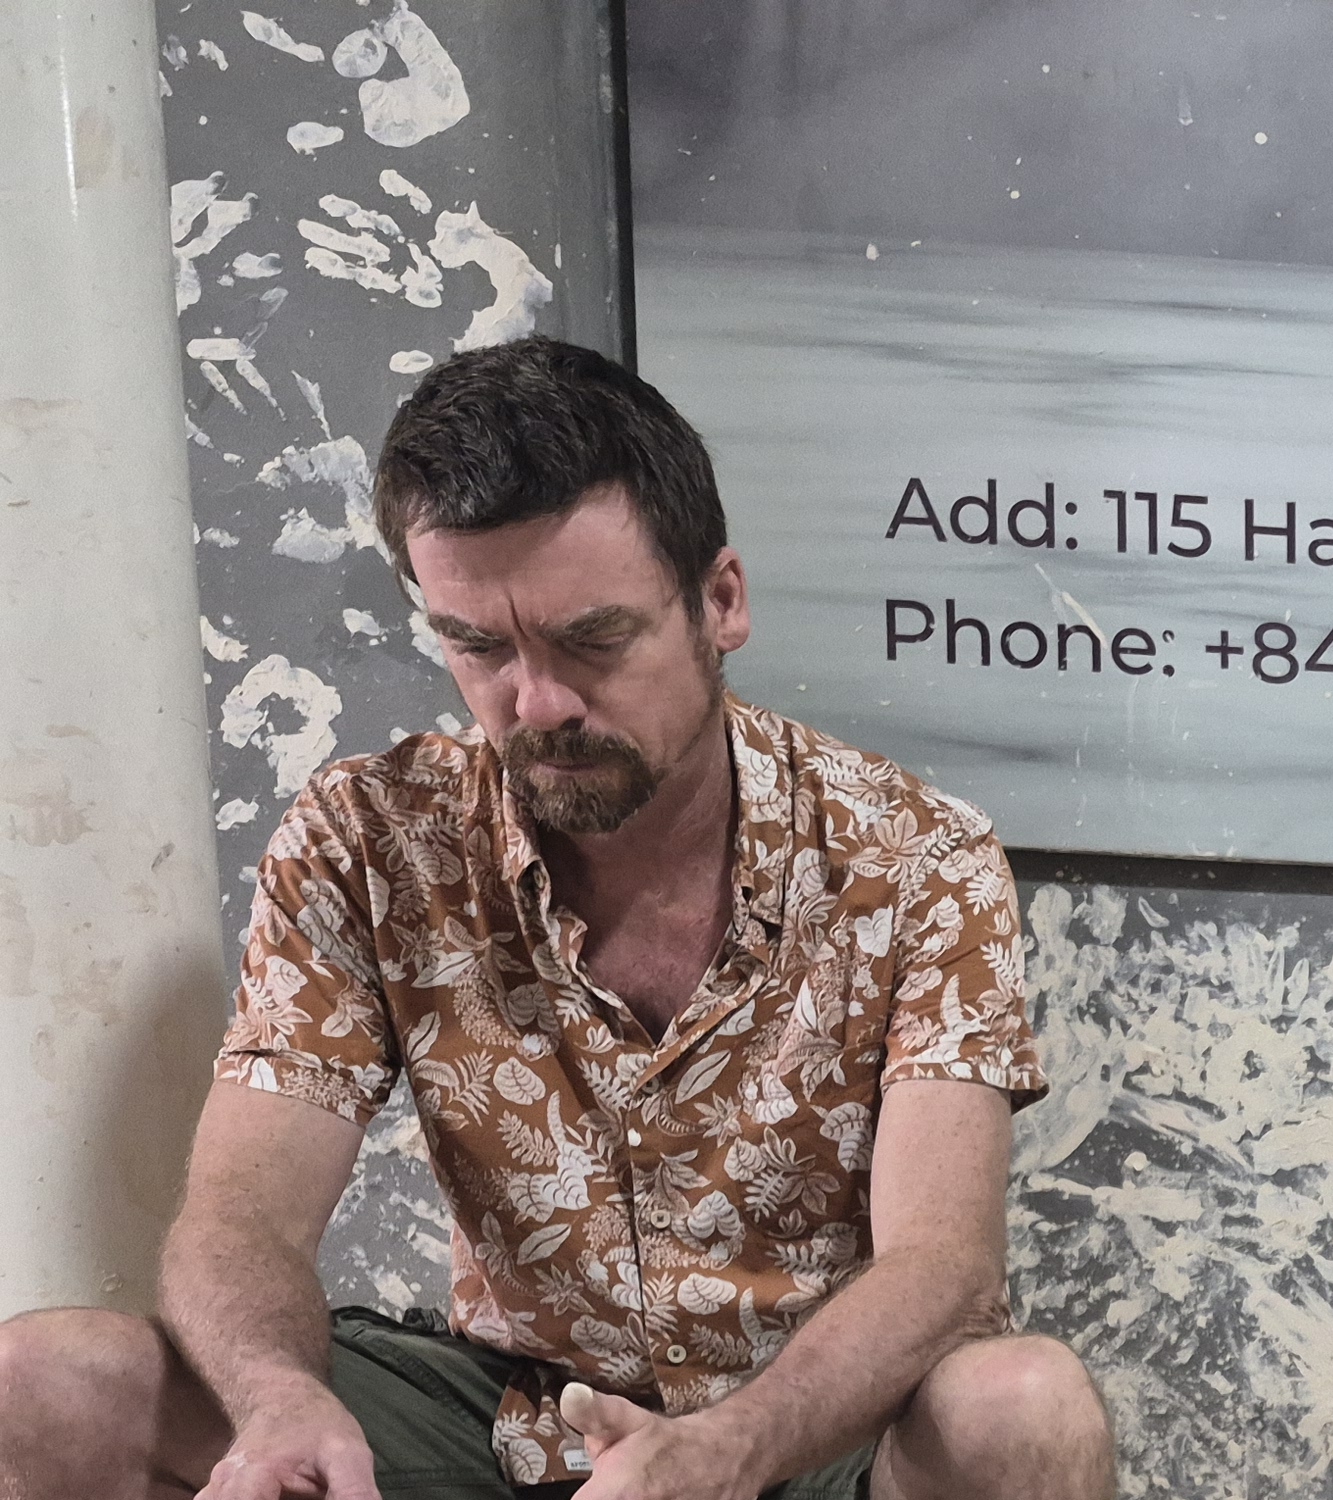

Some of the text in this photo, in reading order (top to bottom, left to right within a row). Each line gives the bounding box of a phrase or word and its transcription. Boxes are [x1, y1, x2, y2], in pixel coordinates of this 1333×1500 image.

[885, 476, 1080, 553] Add:
[1102, 488, 1213, 559] 115
[885, 598, 1180, 675] Phone:
